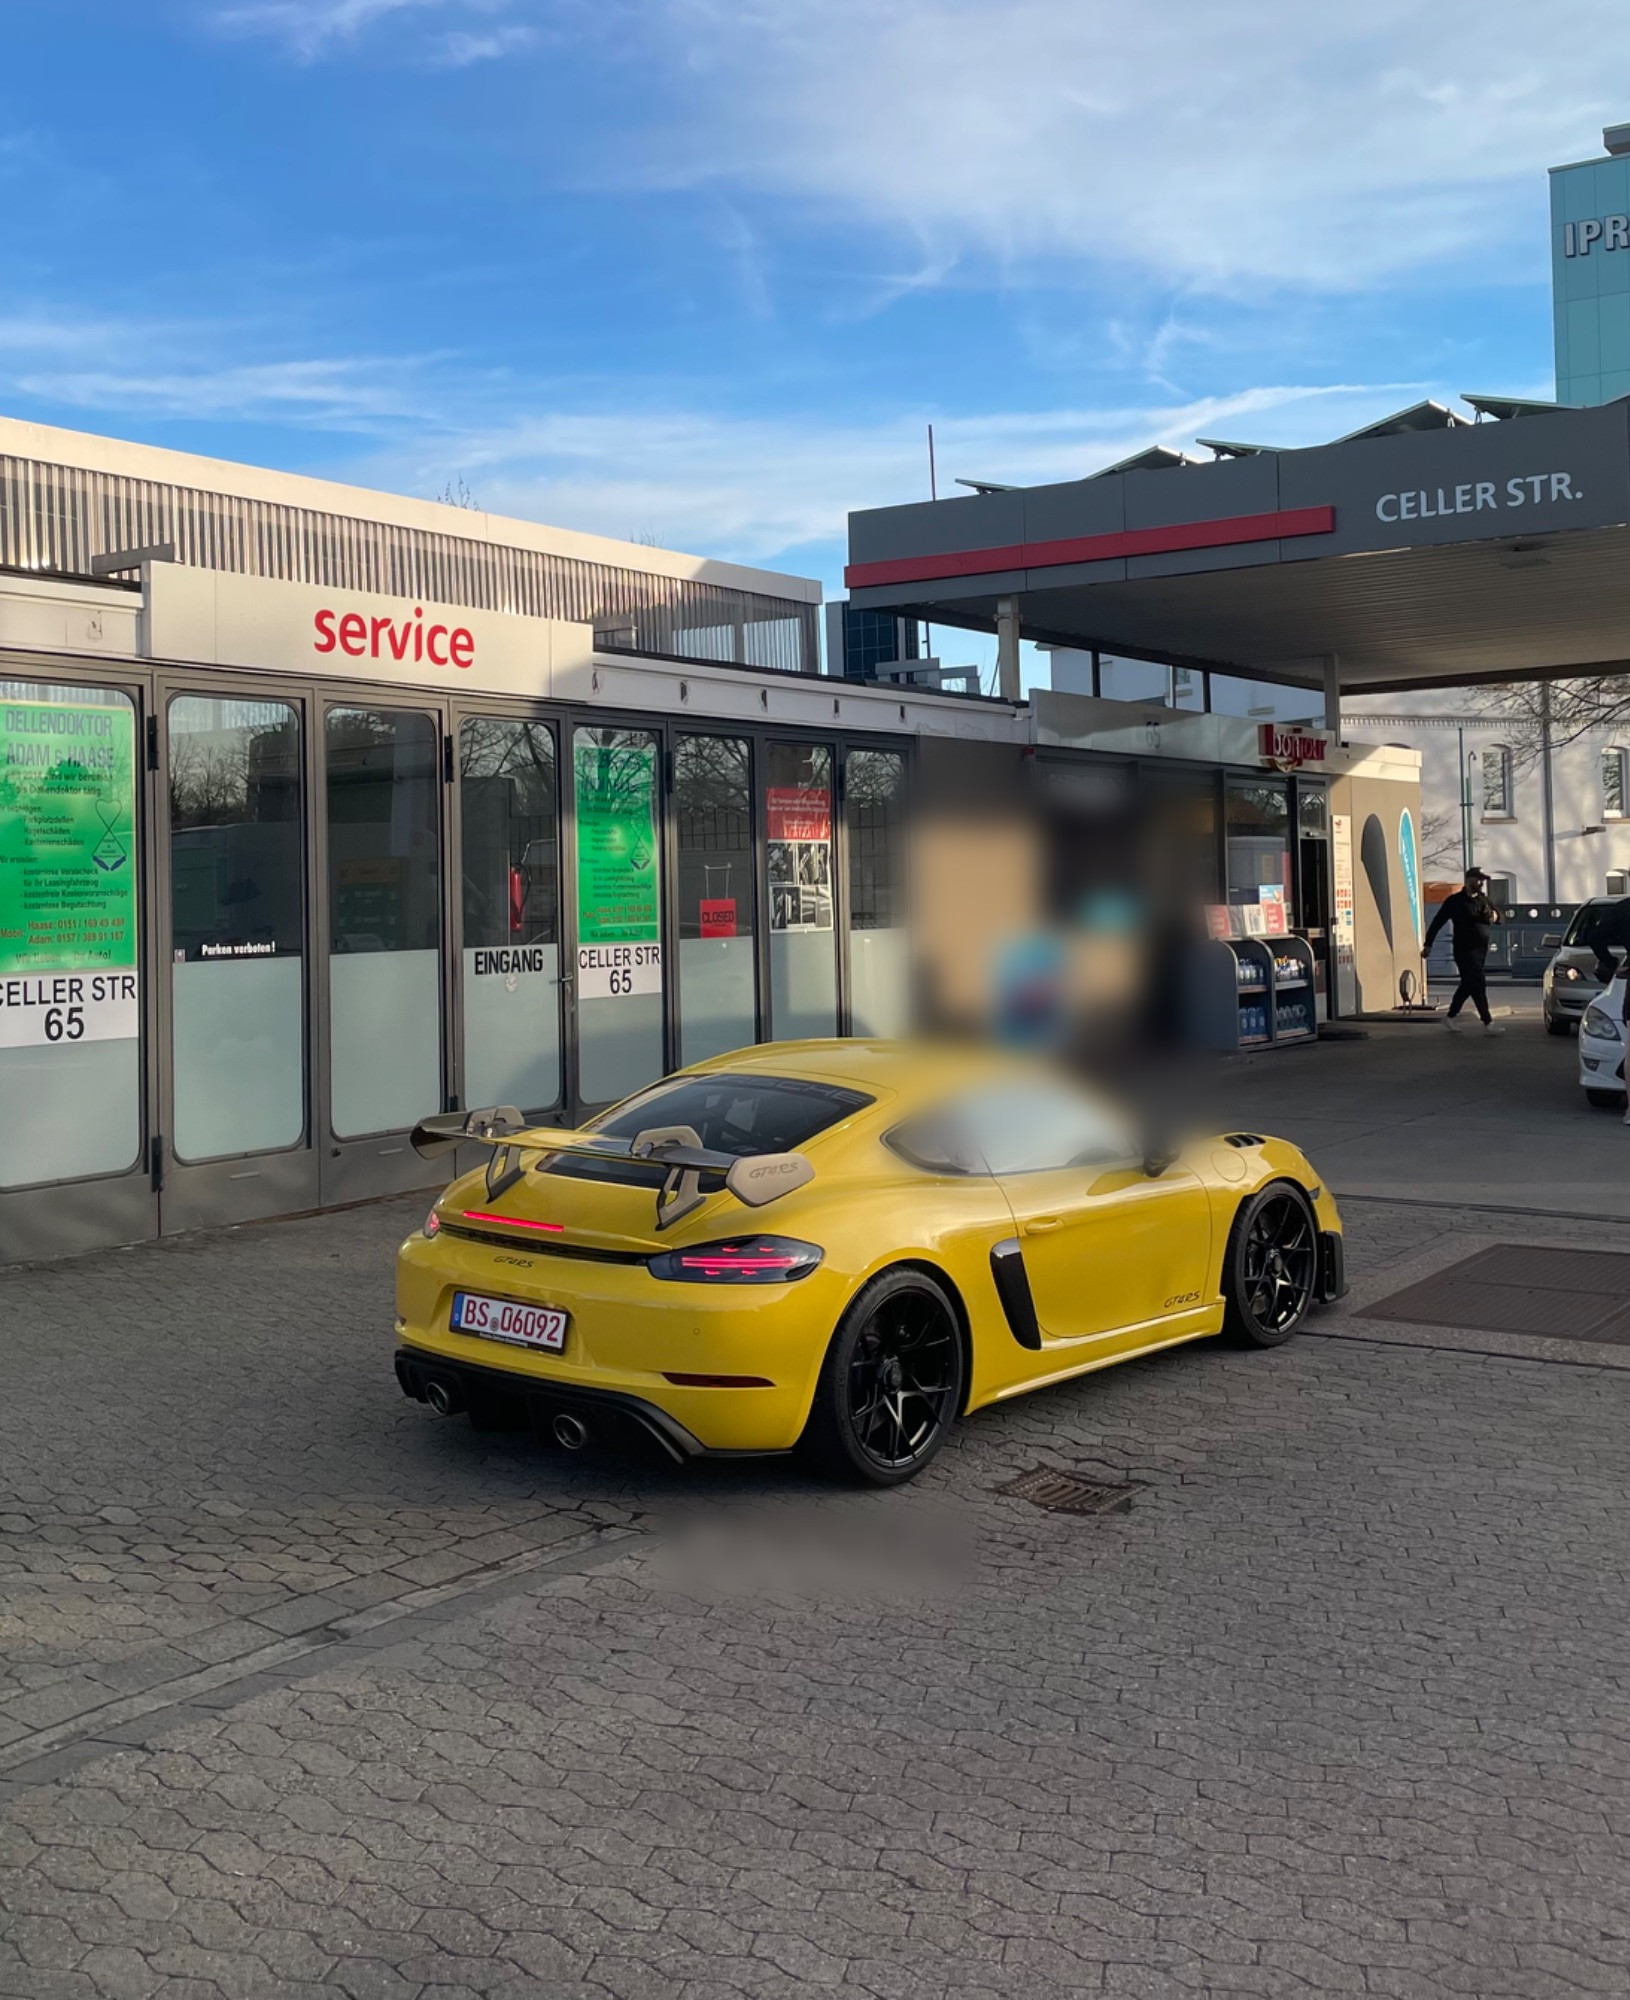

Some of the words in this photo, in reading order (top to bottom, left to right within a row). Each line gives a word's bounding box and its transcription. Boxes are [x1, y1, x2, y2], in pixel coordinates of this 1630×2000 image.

[1565, 214, 1630, 258] IPR
[1375, 481, 1497, 522] CELLER
[1506, 471, 1583, 507] STR.
[314, 606, 475, 669] service
[6, 710, 113, 737] DELLENDOKTOR
[7, 742, 50, 767] ADAM
[67, 745, 114, 769] HAASE
[202, 943, 232, 956] Parken
[475, 948, 543, 976] EINGANG
[579, 947, 632, 970] CELLER
[634, 945, 661, 966] STR
[0, 978, 85, 1008] ELLER
[91, 975, 136, 1002] STR
[609, 969, 632, 995] 65
[44, 1006, 85, 1042] 65
[464, 1299, 490, 1328] BS
[500, 1306, 561, 1343] 06092
